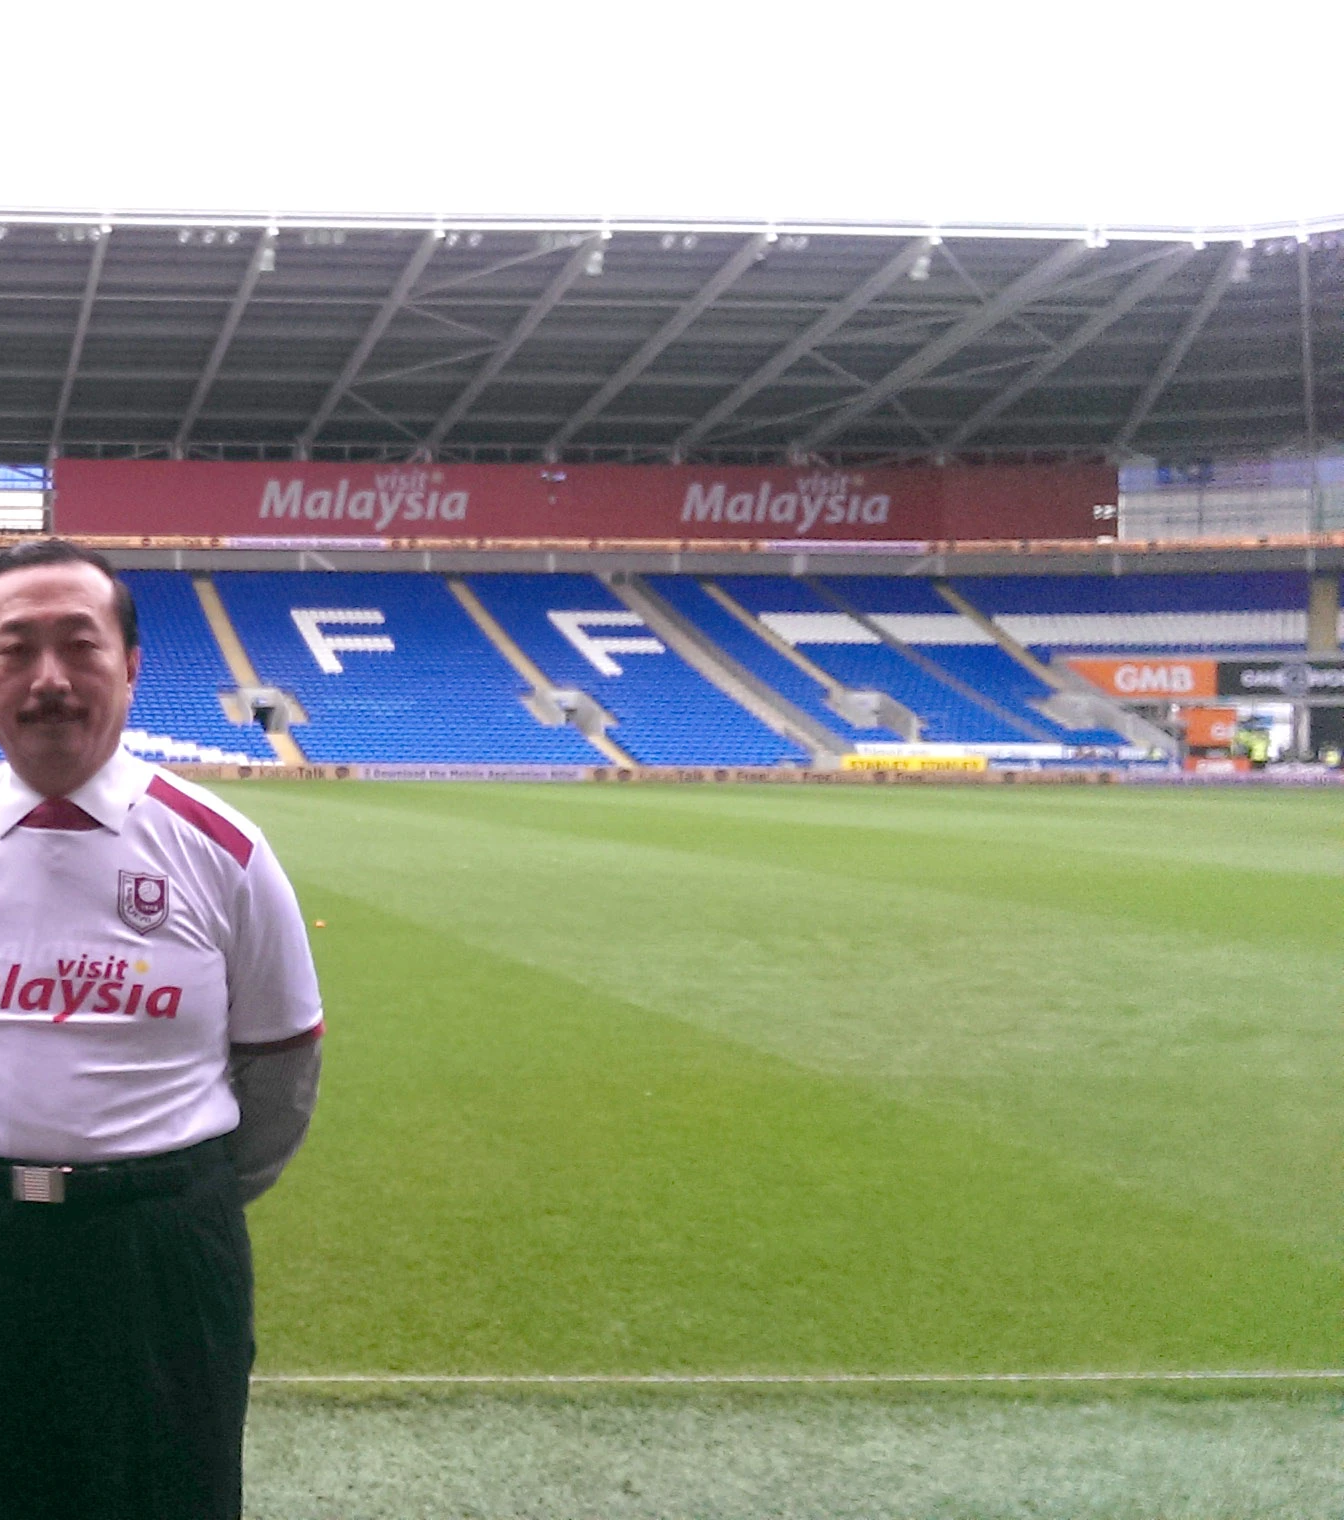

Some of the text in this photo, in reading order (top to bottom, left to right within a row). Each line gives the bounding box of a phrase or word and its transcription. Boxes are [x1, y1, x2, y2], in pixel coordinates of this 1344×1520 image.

[375, 470, 427, 491] visit
[259, 478, 469, 532] Malaysia
[681, 481, 891, 534] Malaysia
[1114, 664, 1195, 693] GMB
[57, 954, 128, 981] visit
